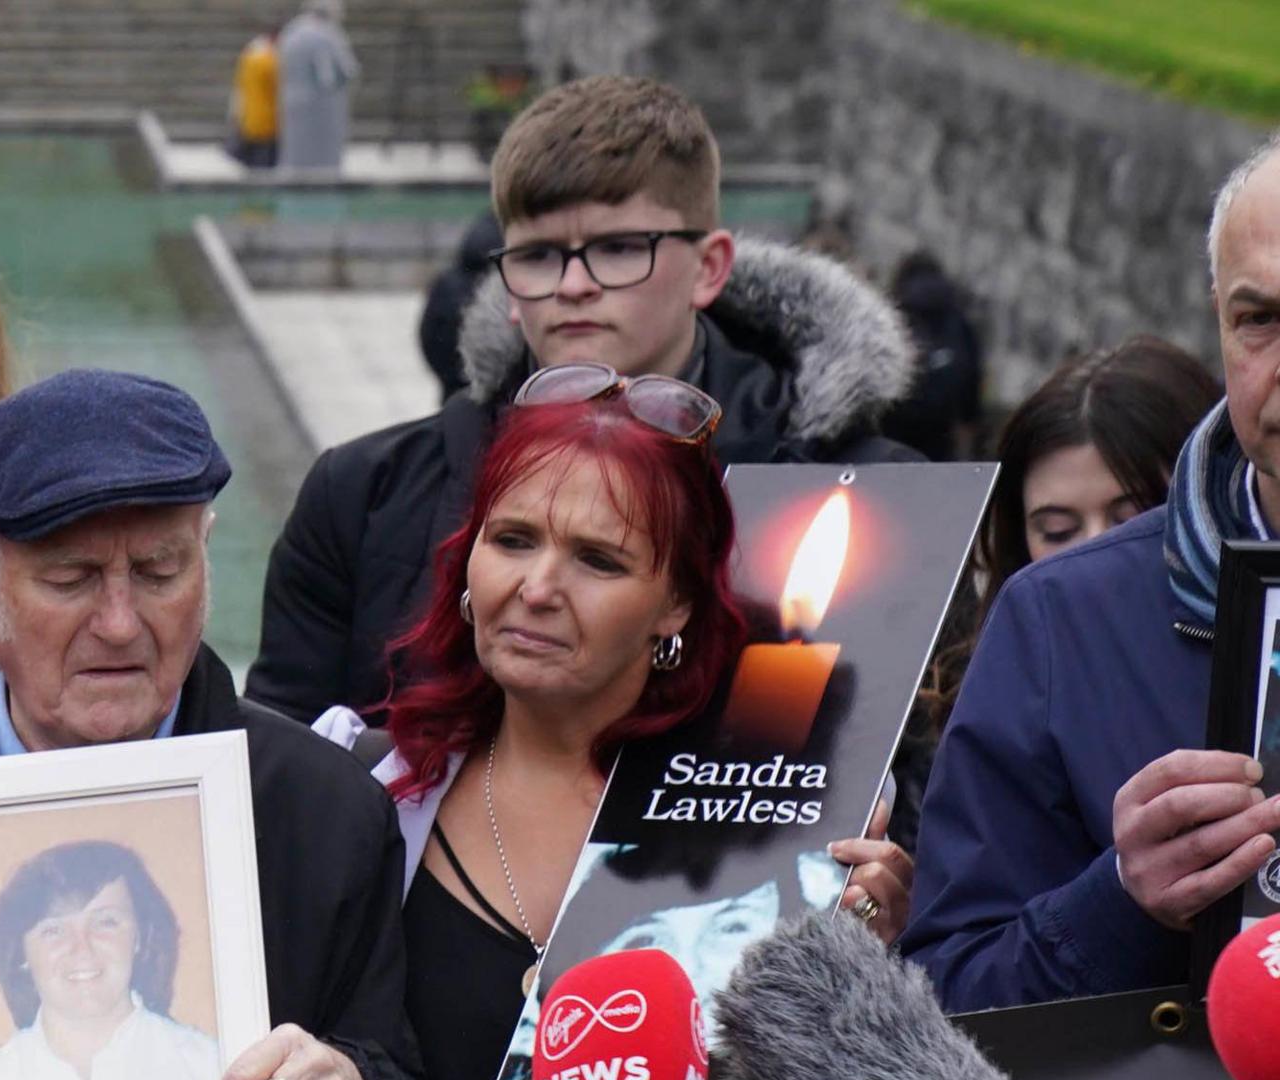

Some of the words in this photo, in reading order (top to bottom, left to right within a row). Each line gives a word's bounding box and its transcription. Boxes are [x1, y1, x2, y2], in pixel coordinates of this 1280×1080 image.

[663, 753, 828, 790] Sandra
[641, 789, 823, 826] Lawless
[545, 1006, 587, 1050] Virgin
[603, 1005, 642, 1018] media
